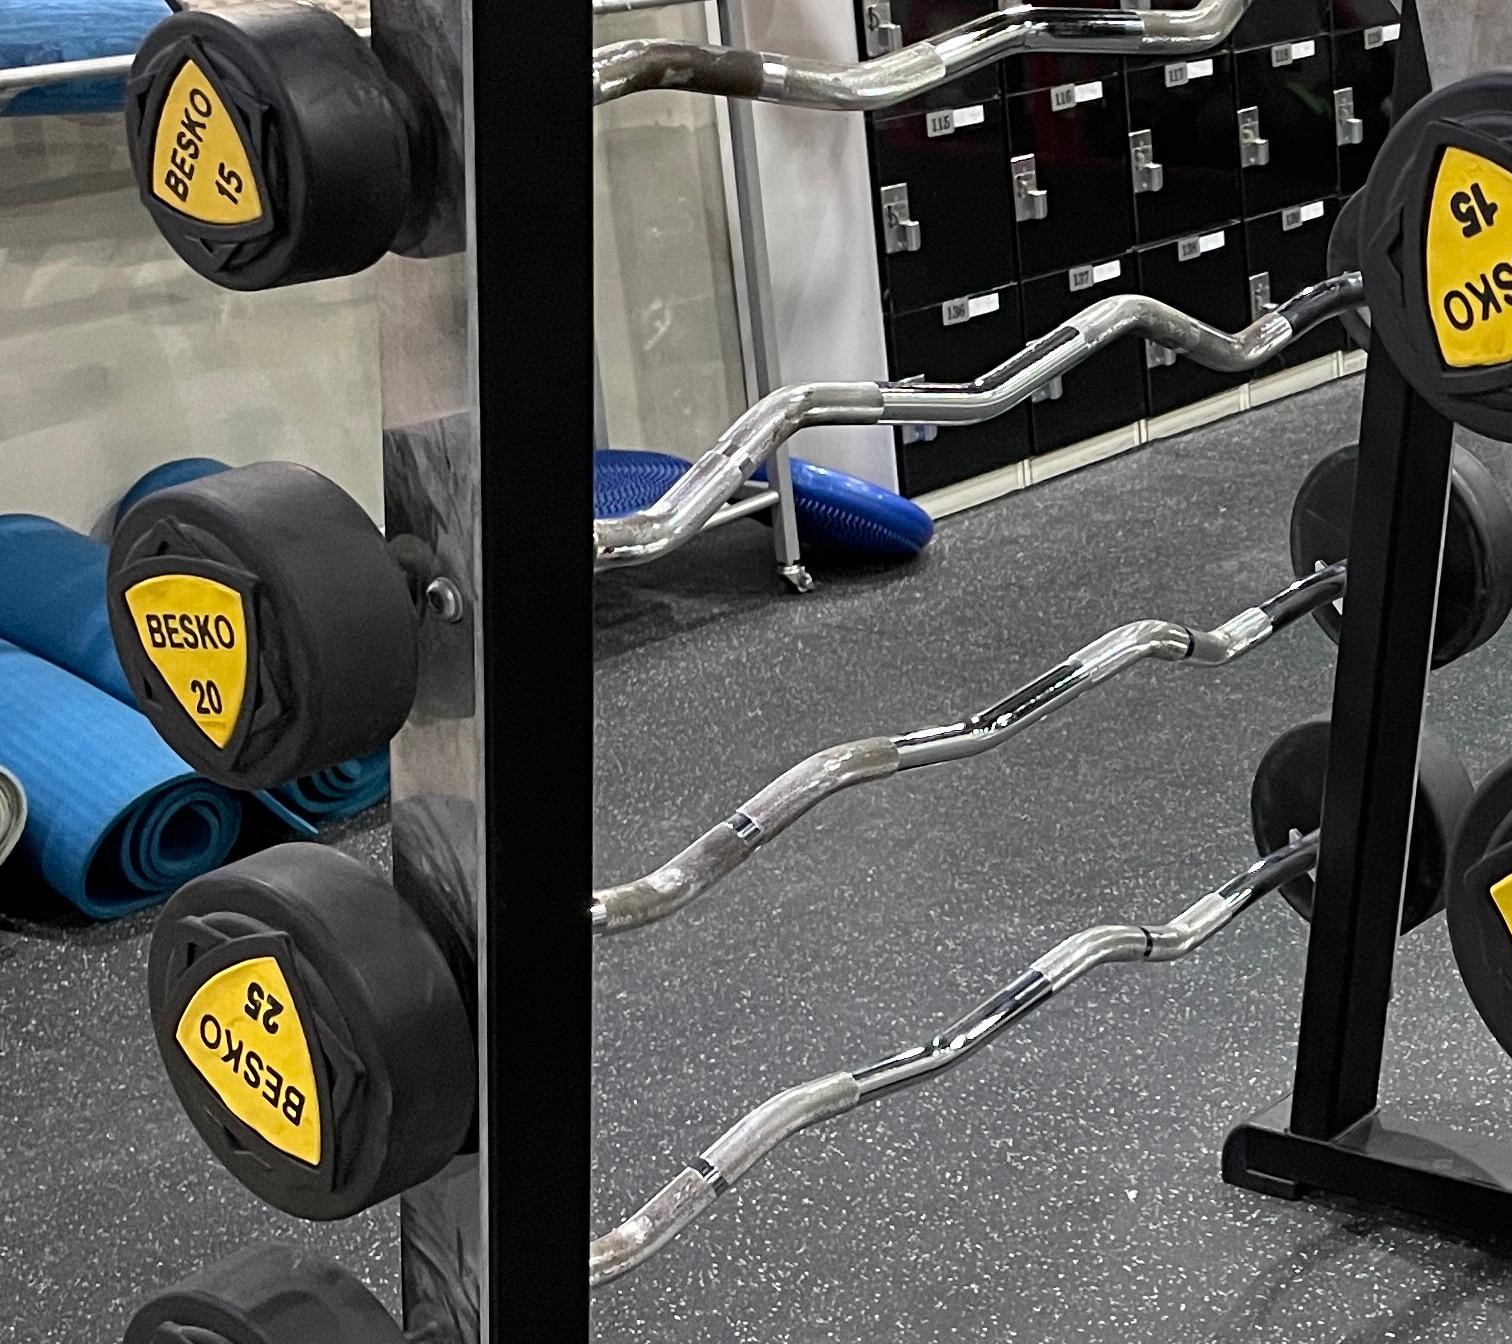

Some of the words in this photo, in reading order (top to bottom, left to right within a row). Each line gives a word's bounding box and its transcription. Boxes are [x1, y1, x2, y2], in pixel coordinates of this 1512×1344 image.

[164, 87, 212, 203] BESKO
[214, 161, 244, 206] 15
[1449, 182, 1499, 239] 15
[145, 613, 235, 650] BESKO
[190, 679, 223, 715] 20
[243, 981, 284, 1035] 25
[199, 1013, 306, 1127] BESKO
